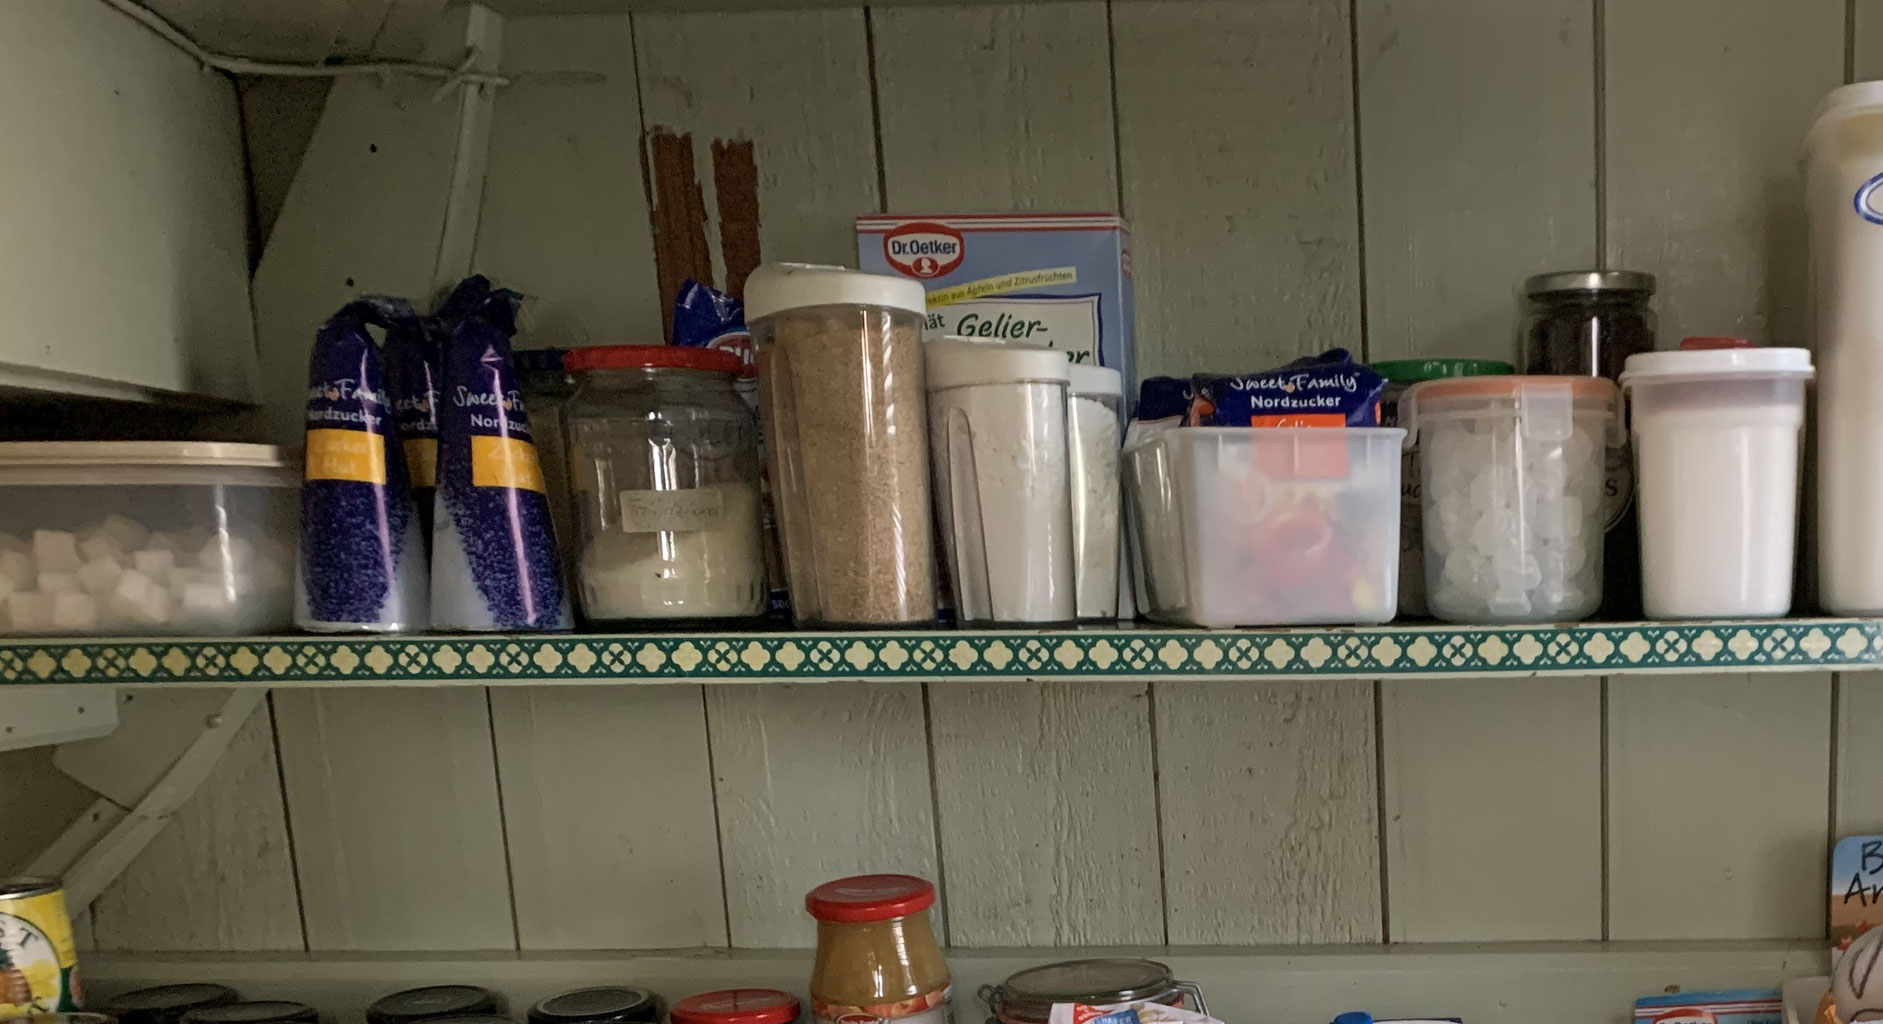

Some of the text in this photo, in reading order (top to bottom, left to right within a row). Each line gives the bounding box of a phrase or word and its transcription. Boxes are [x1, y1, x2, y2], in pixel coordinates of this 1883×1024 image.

[928, 291, 950, 304] ektin
[997, 278, 1012, 290] und
[1014, 270, 1073, 289] Zitrusfrüchten
[957, 312, 1048, 339] Gelier-
[1291, 372, 1357, 392] Family
[1251, 394, 1341, 410] Nordzucker
